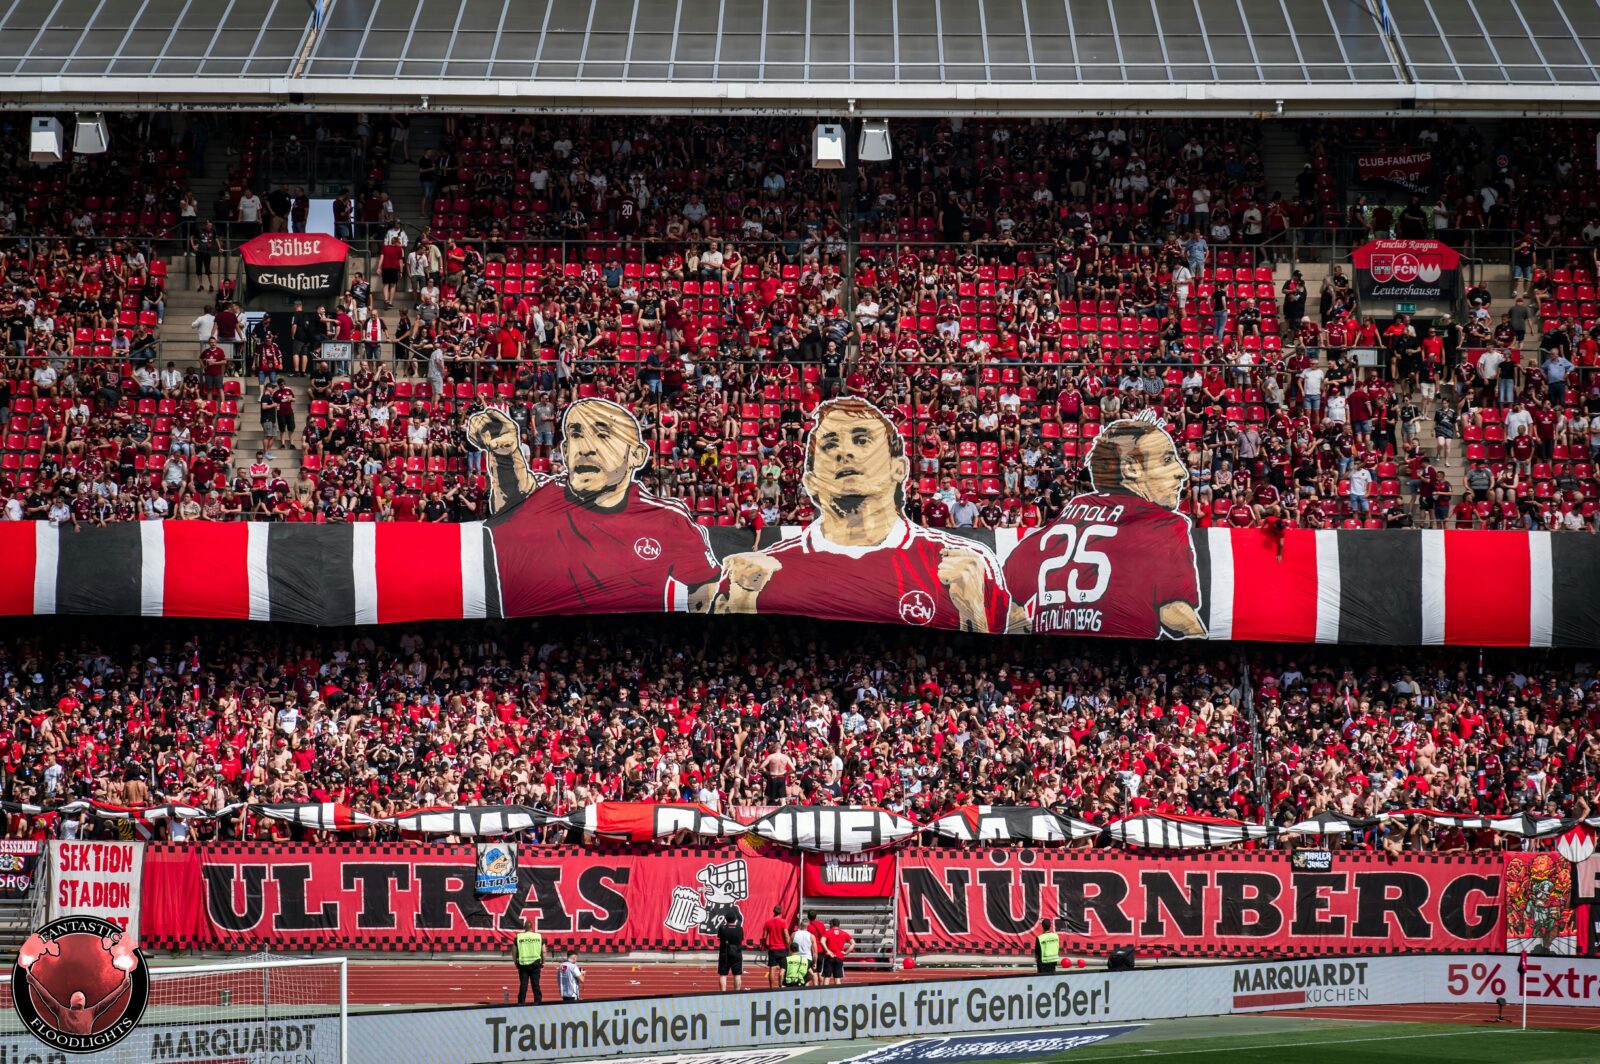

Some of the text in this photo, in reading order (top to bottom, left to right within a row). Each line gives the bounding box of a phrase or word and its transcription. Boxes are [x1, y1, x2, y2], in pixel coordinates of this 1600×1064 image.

[1358, 152, 1432, 167] CLUB-FANATICS
[621, 204, 633, 216] 20
[268, 237, 321, 259] Böhse
[1375, 240, 1438, 252] Fanclub Rangau
[1394, 265, 1417, 274] FCN
[258, 273, 330, 291] Clubfanz
[1372, 284, 1441, 296] Leutershausen
[637, 545, 659, 555] FCN
[1038, 523, 1118, 606] 25
[902, 603, 932, 619] FCN
[59, 843, 133, 873] SEKTION
[58, 879, 130, 908] STADION
[202, 862, 630, 933] ULTRAS
[900, 850, 1500, 939] NÜRNBERG
[1233, 962, 1368, 992] MARQUARDT
[1447, 963, 1600, 998] 5% Extr
[1306, 988, 1369, 1003] KÜCHEN
[486, 1007, 708, 1053] Traumküchen
[751, 992, 907, 1039] Heimspiel
[915, 989, 959, 1026] für
[966, 980, 1111, 1024] Genießer!
[151, 1024, 315, 1060] MARQUARDT
